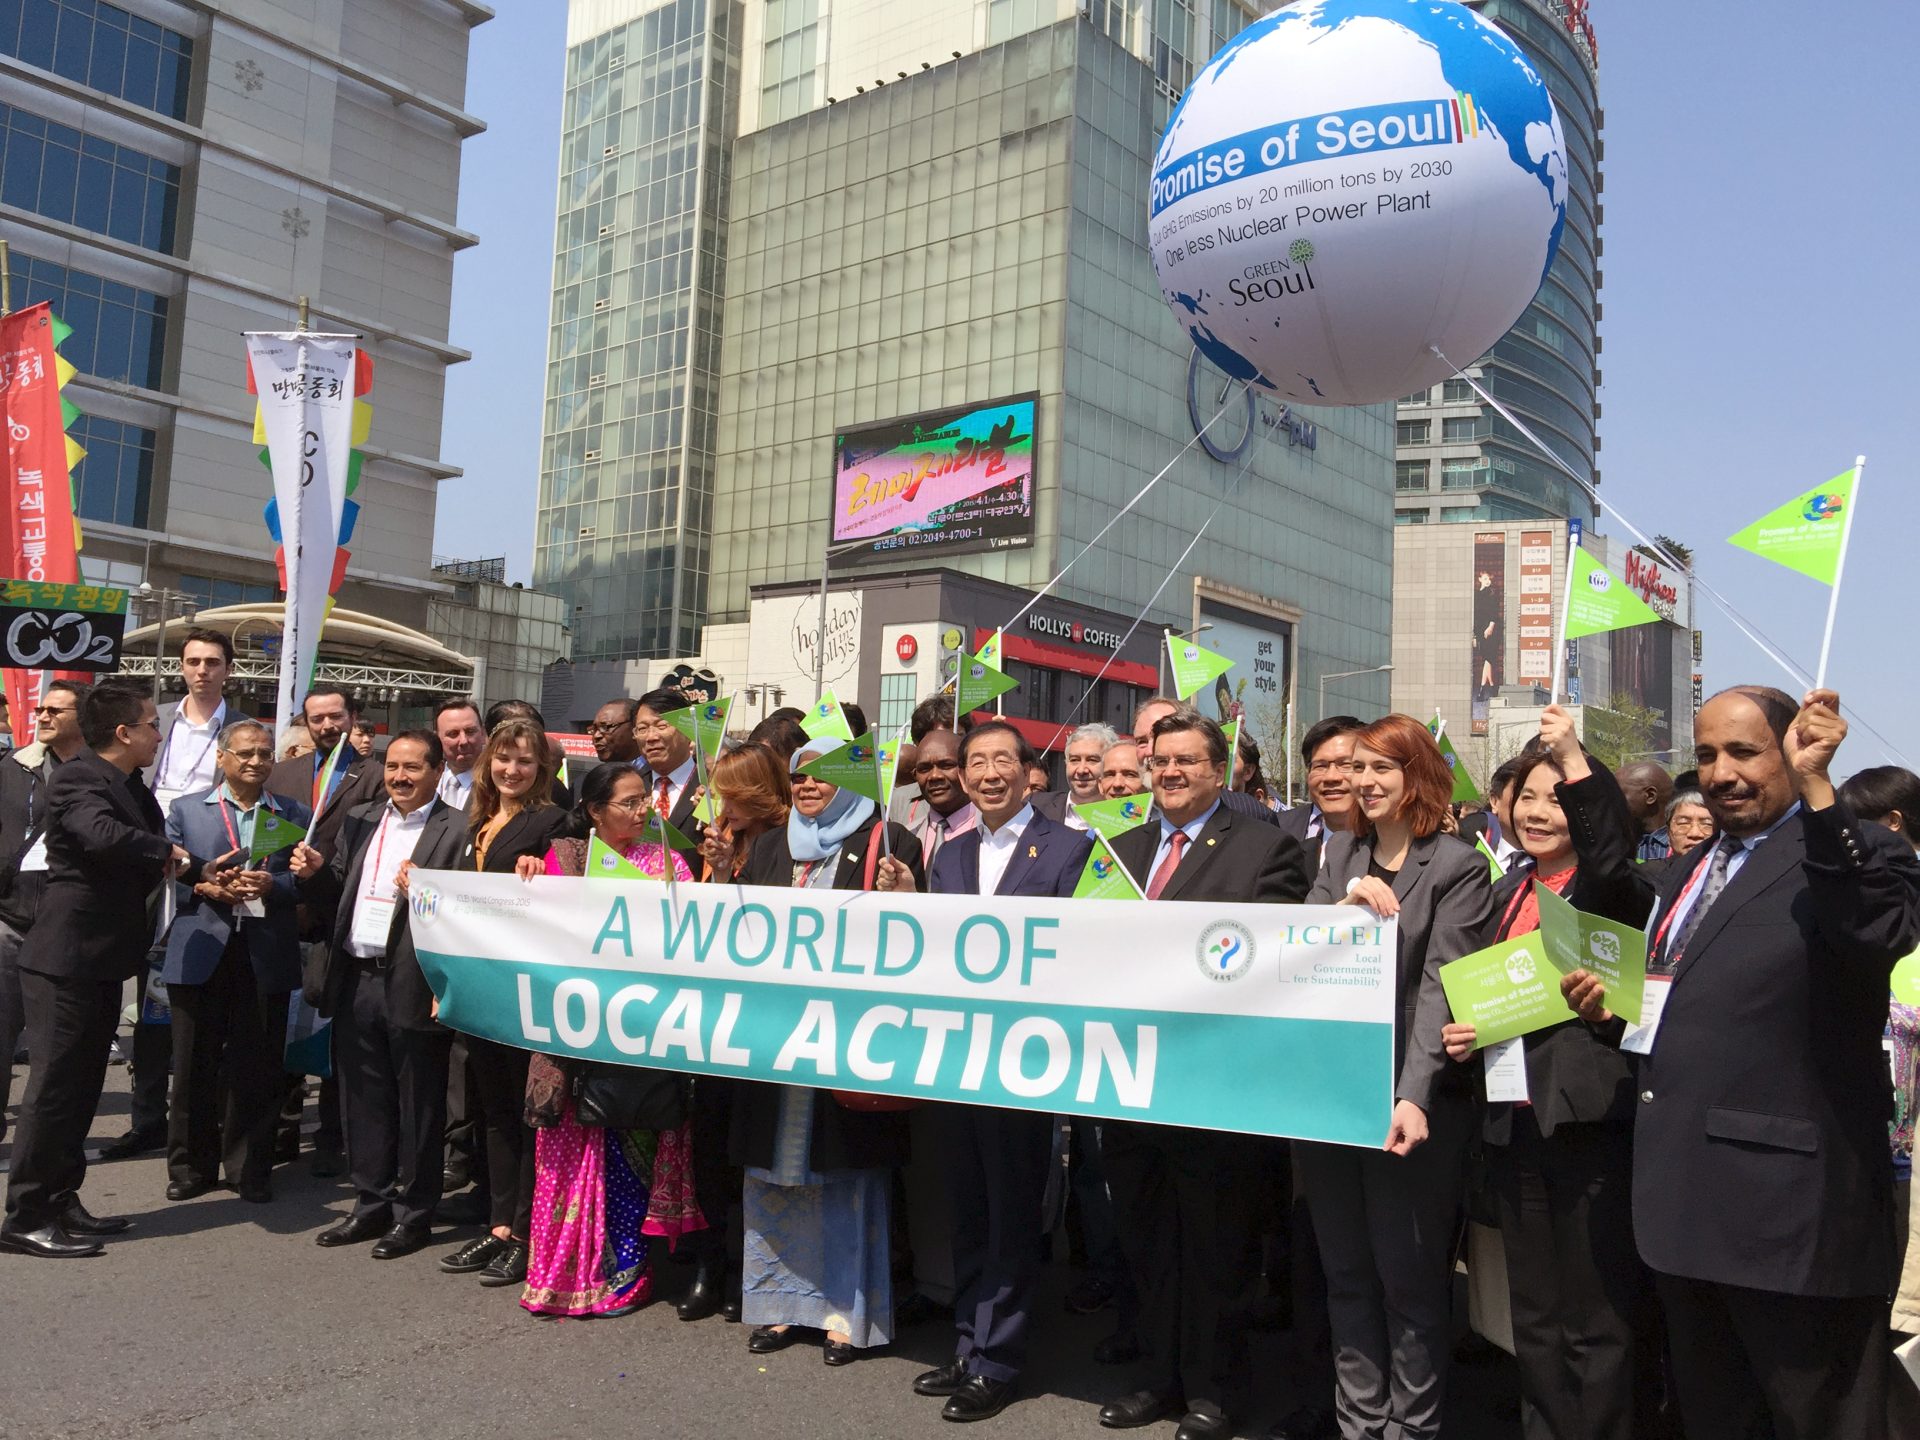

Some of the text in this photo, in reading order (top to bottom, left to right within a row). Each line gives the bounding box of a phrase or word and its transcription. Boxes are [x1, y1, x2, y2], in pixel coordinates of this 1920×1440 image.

[1152, 104, 1446, 210] Promise of Seoul
[1178, 201, 1232, 230] Emissions
[1237, 195, 1253, 213] by
[1259, 187, 1278, 204] 20
[1284, 177, 1334, 198] million
[1340, 172, 1376, 190] tons
[1383, 167, 1402, 187] by
[1410, 160, 1453, 178] 2030
[1166, 190, 1432, 267] One less Nuclear Power Plant
[1244, 259, 1290, 281] GREEN
[1228, 266, 1315, 307] Seoul
[72, 586, 123, 612] 관악
[796, 607, 858, 653] hoiday
[1029, 614, 1121, 649] HOLLYS COFFEE
[1258, 640, 1272, 655] get
[1254, 658, 1276, 673] your
[1254, 676, 1276, 693] style
[591, 896, 1061, 987] A WORLD OF
[1313, 963, 1382, 975] Governments
[1355, 953, 1382, 964] Local
[1594, 961, 1620, 978] Seoul
[1293, 974, 1382, 988] for Sustainability
[1472, 982, 1545, 1012] Promise of Seoul
[517, 973, 1158, 1109] LOCAL ACTION
